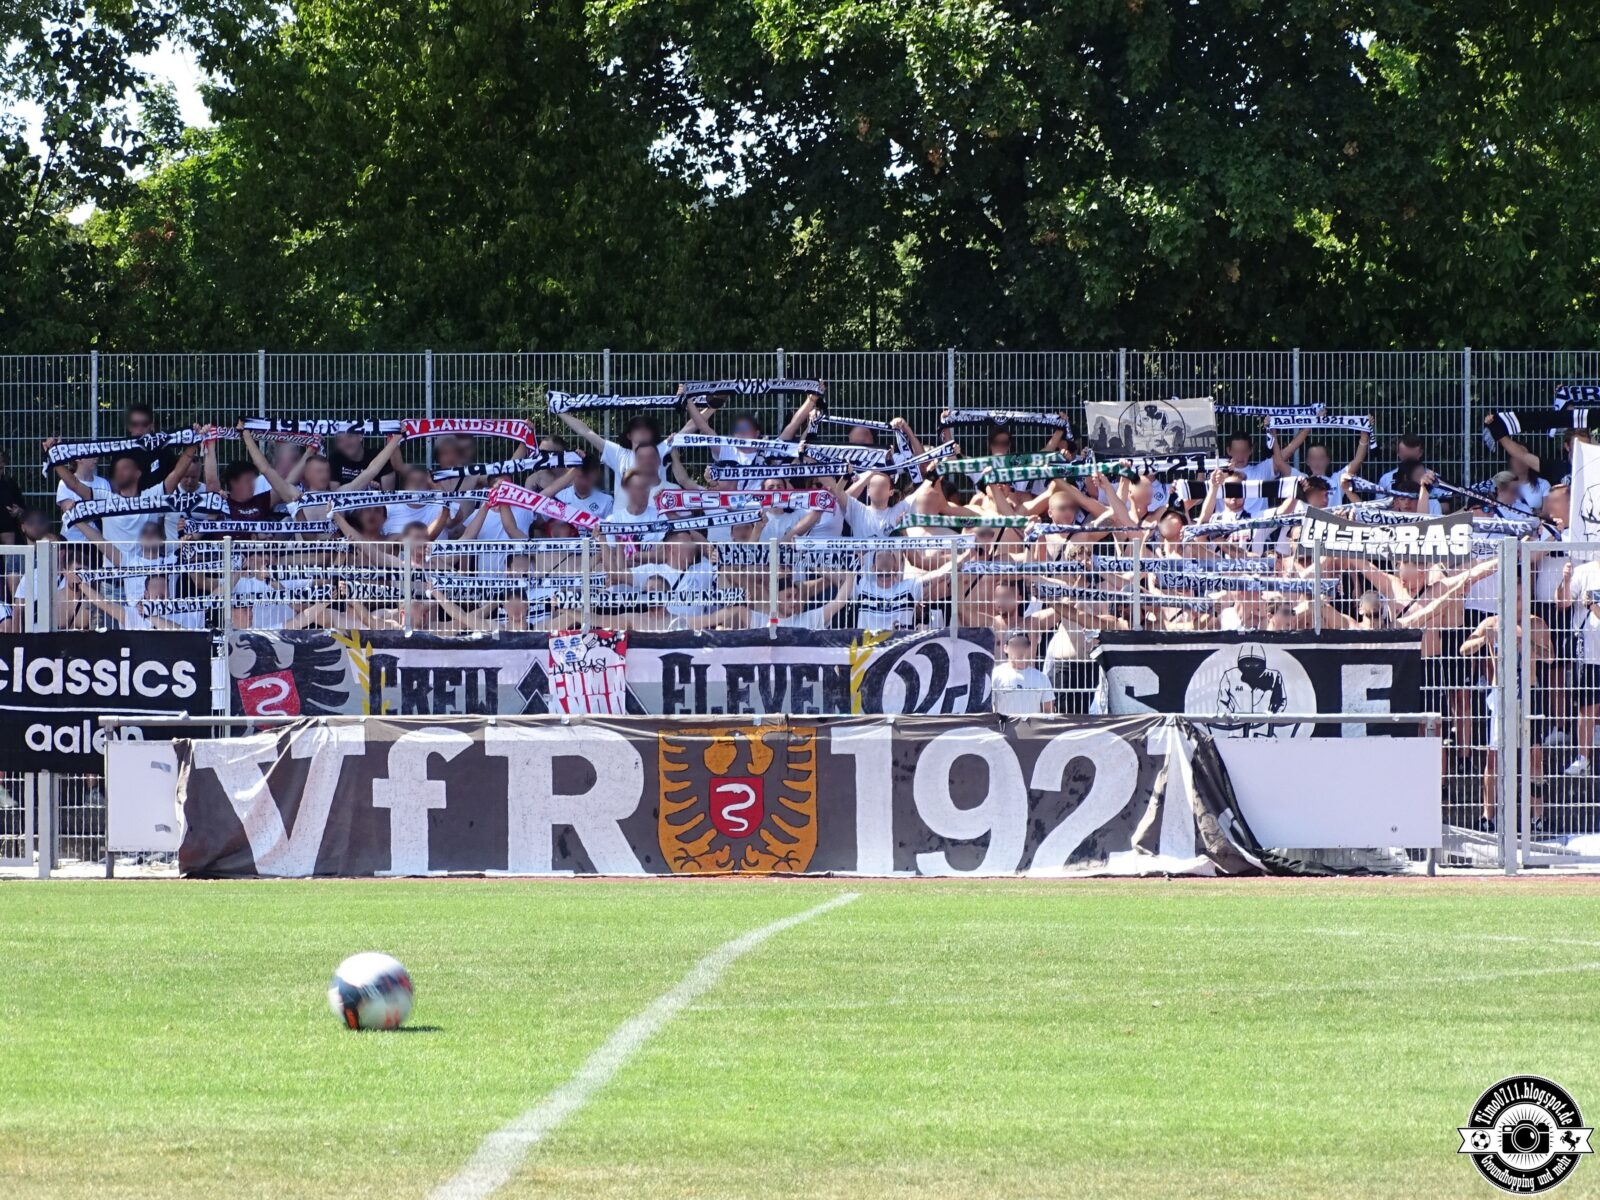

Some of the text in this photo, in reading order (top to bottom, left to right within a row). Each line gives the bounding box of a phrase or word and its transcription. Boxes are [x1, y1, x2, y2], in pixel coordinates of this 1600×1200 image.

[429, 418, 532, 441] LANDSHUT
[1274, 416, 1312, 426] Aalen
[1316, 416, 1344, 426] 1921
[683, 435, 721, 445] SUPER
[742, 468, 781, 478] STADT
[783, 465, 806, 476] UND
[220, 522, 257, 532] STADT
[261, 521, 283, 531] UND
[285, 520, 330, 532] VEREIN
[673, 510, 762, 530] CREW ELEVEN
[1302, 516, 1473, 557] ULTRAS
[0, 646, 198, 699] lassics
[193, 724, 647, 877] VfR
